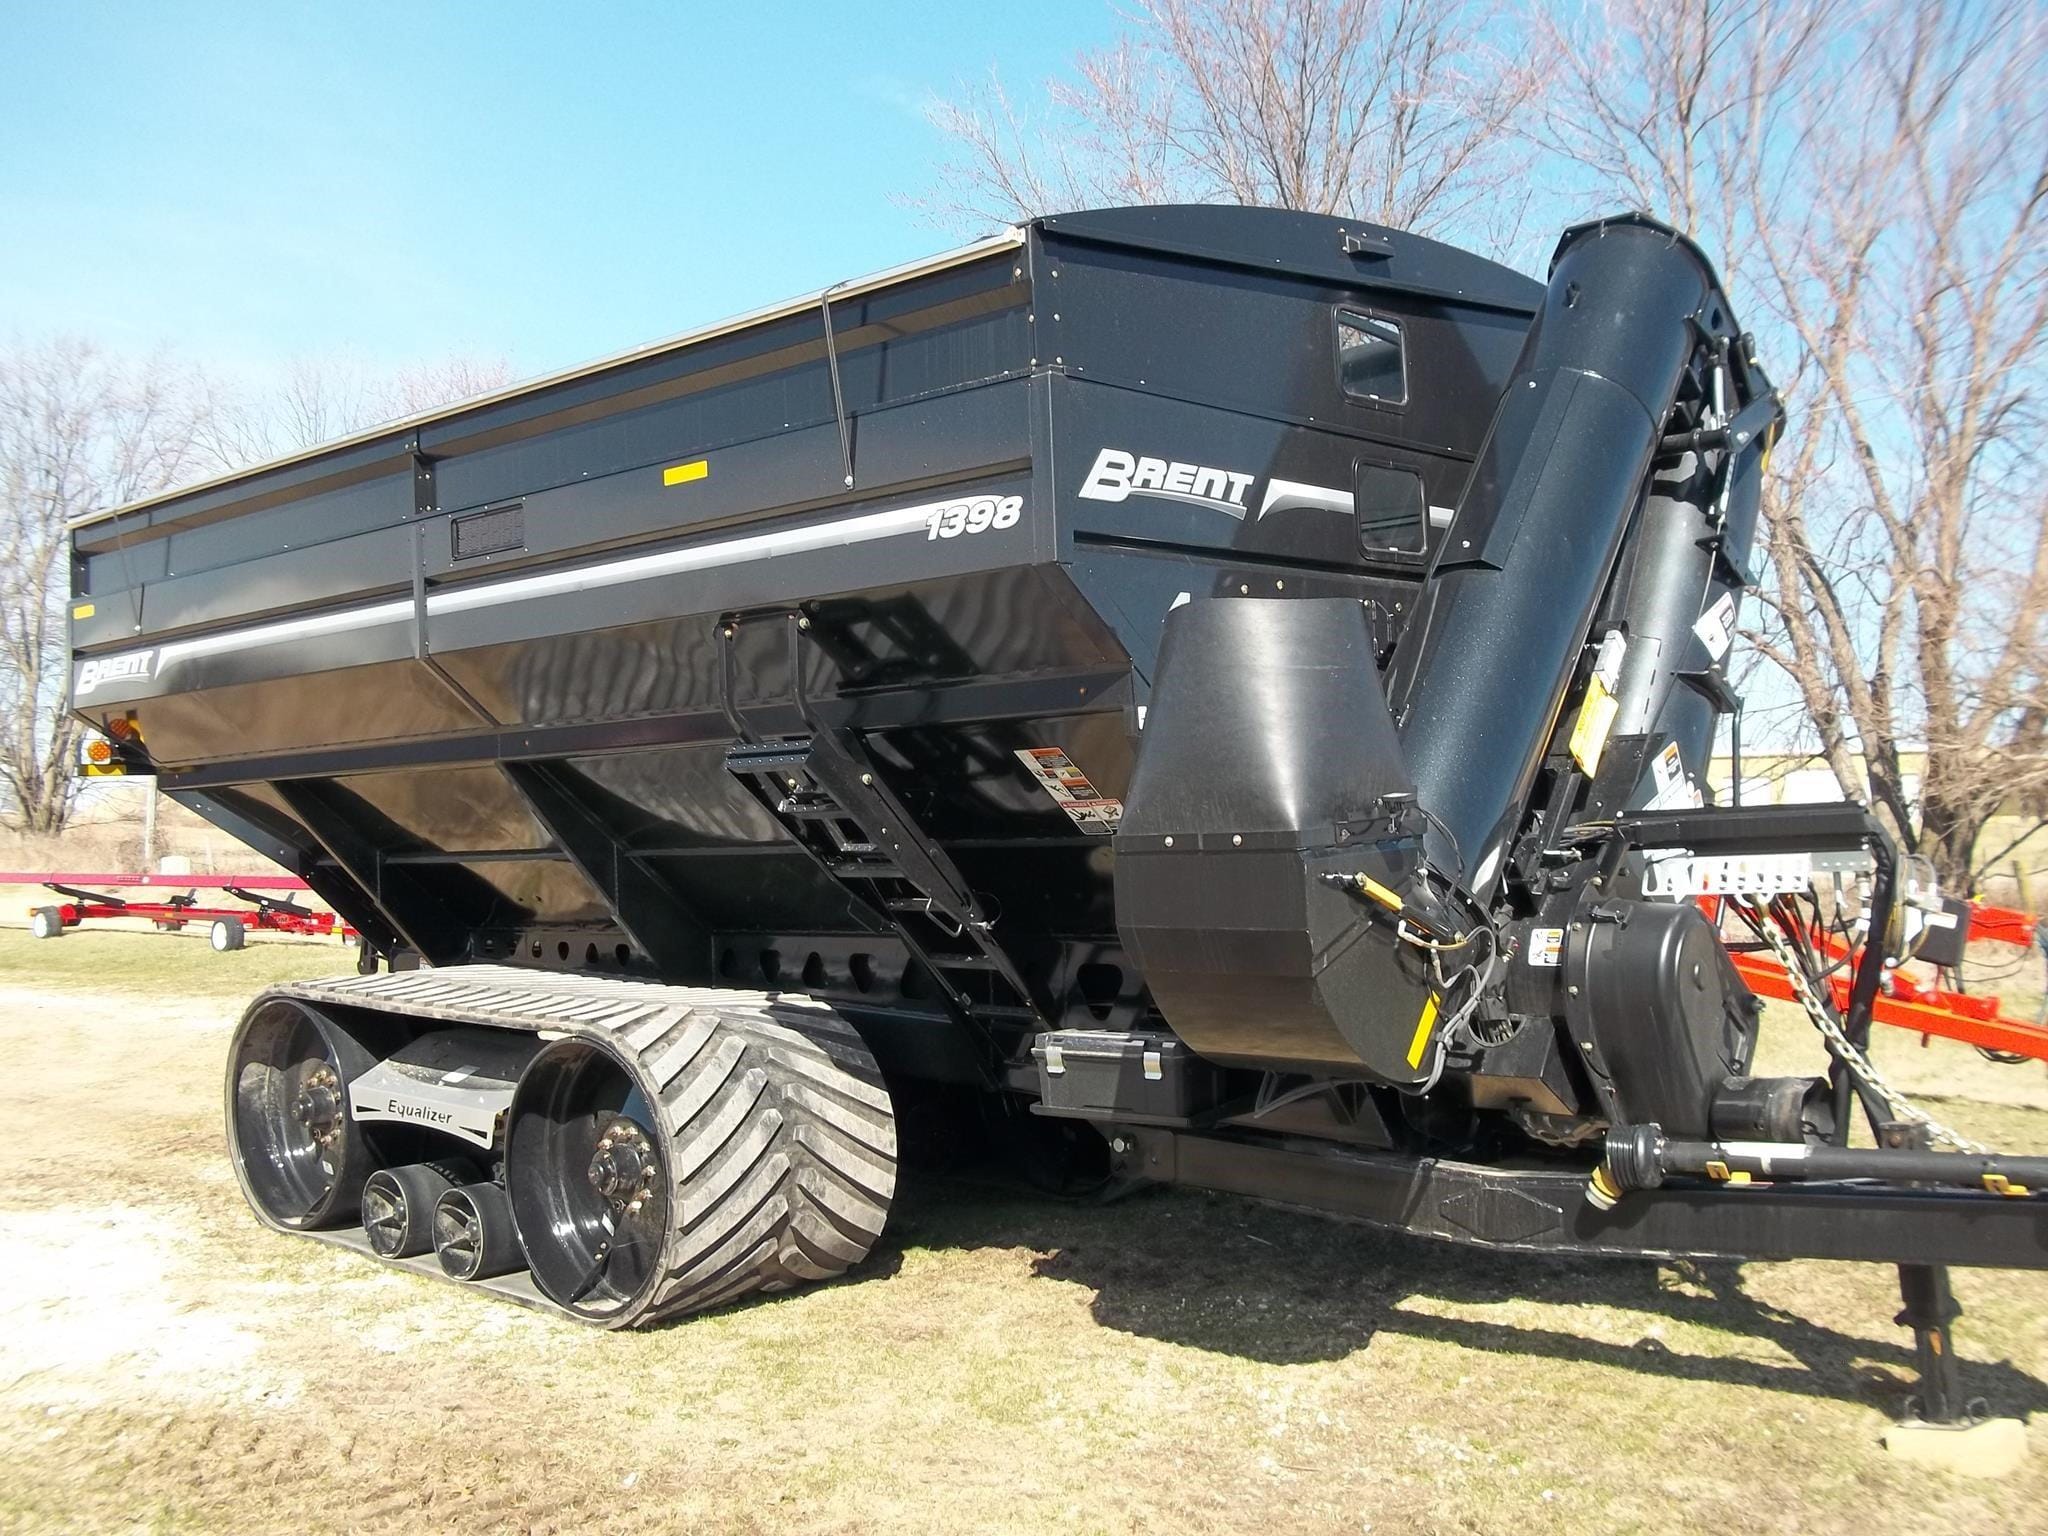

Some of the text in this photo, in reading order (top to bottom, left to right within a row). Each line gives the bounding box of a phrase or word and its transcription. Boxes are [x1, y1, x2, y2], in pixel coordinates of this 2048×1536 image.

[1078, 448, 1255, 505] BRENT
[926, 495, 1023, 541] 1398
[388, 1099, 452, 1124] Equalizer
